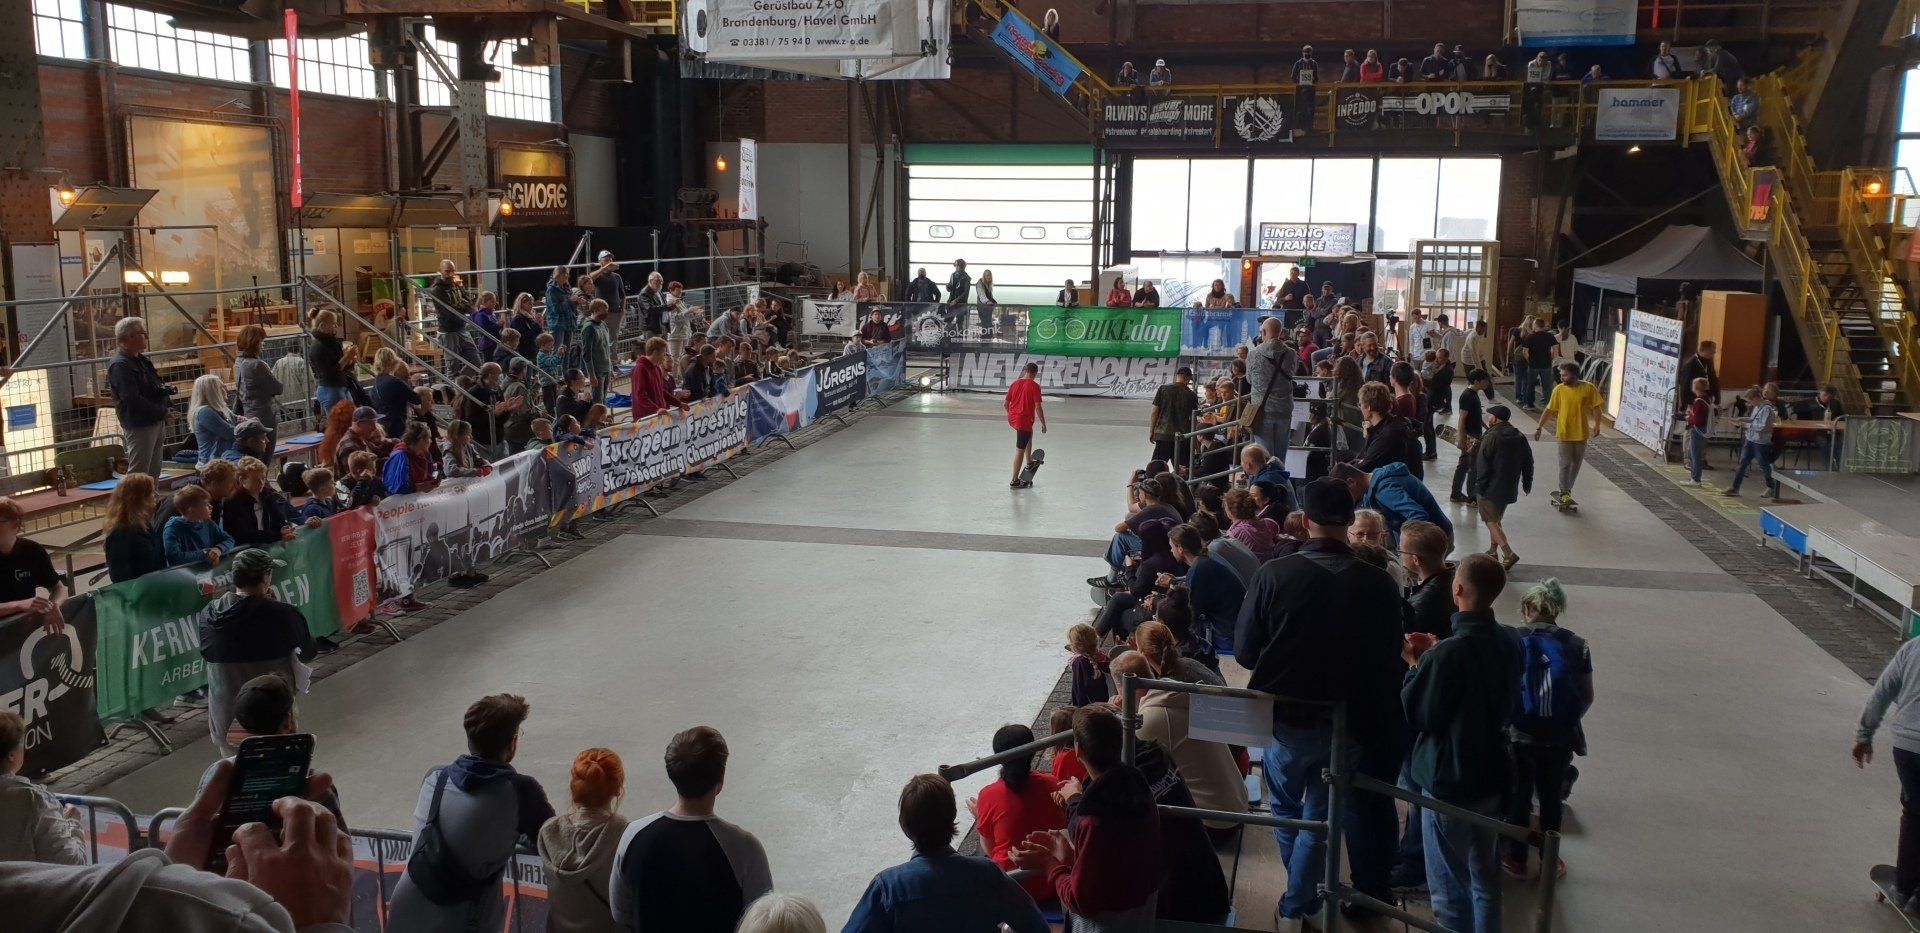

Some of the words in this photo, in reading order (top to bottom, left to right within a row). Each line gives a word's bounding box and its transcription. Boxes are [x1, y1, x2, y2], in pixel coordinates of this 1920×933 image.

[753, 0, 812, 11] Gerüstbau
[722, 16, 837, 29] Brandenburg/Havel
[840, 14, 877, 26] GmbH
[778, 37, 788, 46] 75
[816, 37, 869, 46] www.z-o.de
[1105, 105, 1148, 121] ALWAYS
[1183, 104, 1213, 121] MORE
[1415, 91, 1475, 116] OPOR
[1612, 96, 1666, 108] hammer
[1264, 227, 1325, 240] EINGANG
[1260, 240, 1326, 252] ENTRANCE
[600, 424, 681, 466] European
[685, 399, 748, 444] Freestyle
[571, 455, 592, 478] EURO
[602, 453, 686, 496] Skateboarding
[685, 424, 748, 465] Championship
[376, 501, 415, 521] People
[132, 611, 201, 670] KERN
[268, 573, 310, 607] DEN
[161, 657, 204, 686] ARBEI
[0, 677, 49, 726] ER
[24, 720, 53, 750] ON
